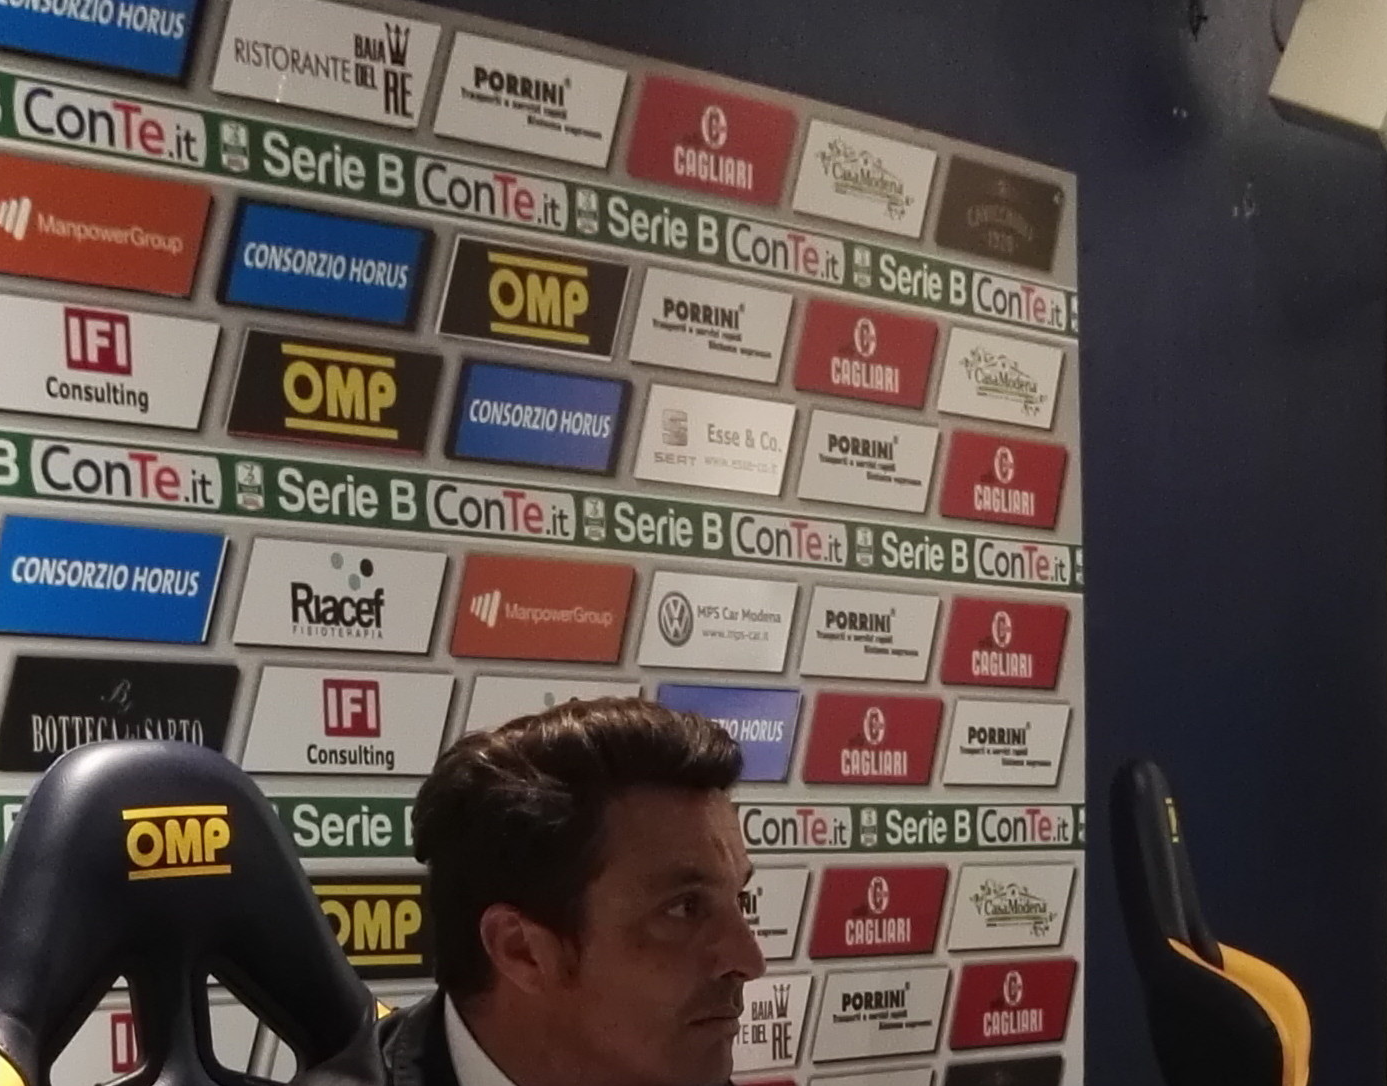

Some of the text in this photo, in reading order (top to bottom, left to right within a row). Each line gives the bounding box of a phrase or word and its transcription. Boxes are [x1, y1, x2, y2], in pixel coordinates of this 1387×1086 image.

[118, 3, 186, 39] HORUS
[235, 34, 385, 84] RISTORANTE BAIA
[355, 63, 413, 119] DEL RE
[474, 66, 564, 107] PORRINI
[263, 131, 405, 197] Serie B
[674, 146, 753, 190] CAGLIARI
[422, 163, 561, 227] ConTe.it
[38, 212, 183, 254] ManpowerGroup
[243, 241, 408, 290] CONSORZIO HORUS
[879, 256, 966, 306] Serie B
[489, 268, 589, 328] OMP
[977, 278, 1062, 327] ConTe.it
[469, 399, 611, 439] CONSORZIO HORUS
[707, 423, 783, 453] Esse & Co.
[277, 468, 416, 521] Serie B
[434, 485, 569, 536] ConTe.it
[974, 487, 1035, 517] CAGLIARI
[882, 531, 968, 574] Serie B
[979, 541, 1066, 583] ConTe.it
[12, 556, 199, 597] CONSORZIO HORUS
[290, 582, 385, 629] Riacef
[505, 602, 613, 628] ManpowerGroup
[697, 605, 781, 624] MPS Car Modena
[826, 610, 891, 633] PORRINI
[292, 624, 384, 640] FISIOTERAPIA
[327, 684, 376, 730] IFI
[740, 719, 784, 742] HORUS
[307, 744, 394, 771] Consulting
[126, 817, 230, 867] OMP
[293, 803, 391, 848] Serie
[743, 808, 847, 846] ConTe.it
[845, 918, 911, 946] CAGLIARI
[842, 988, 906, 1011] PORRINI
[983, 1009, 1043, 1037] CAGLIARI
